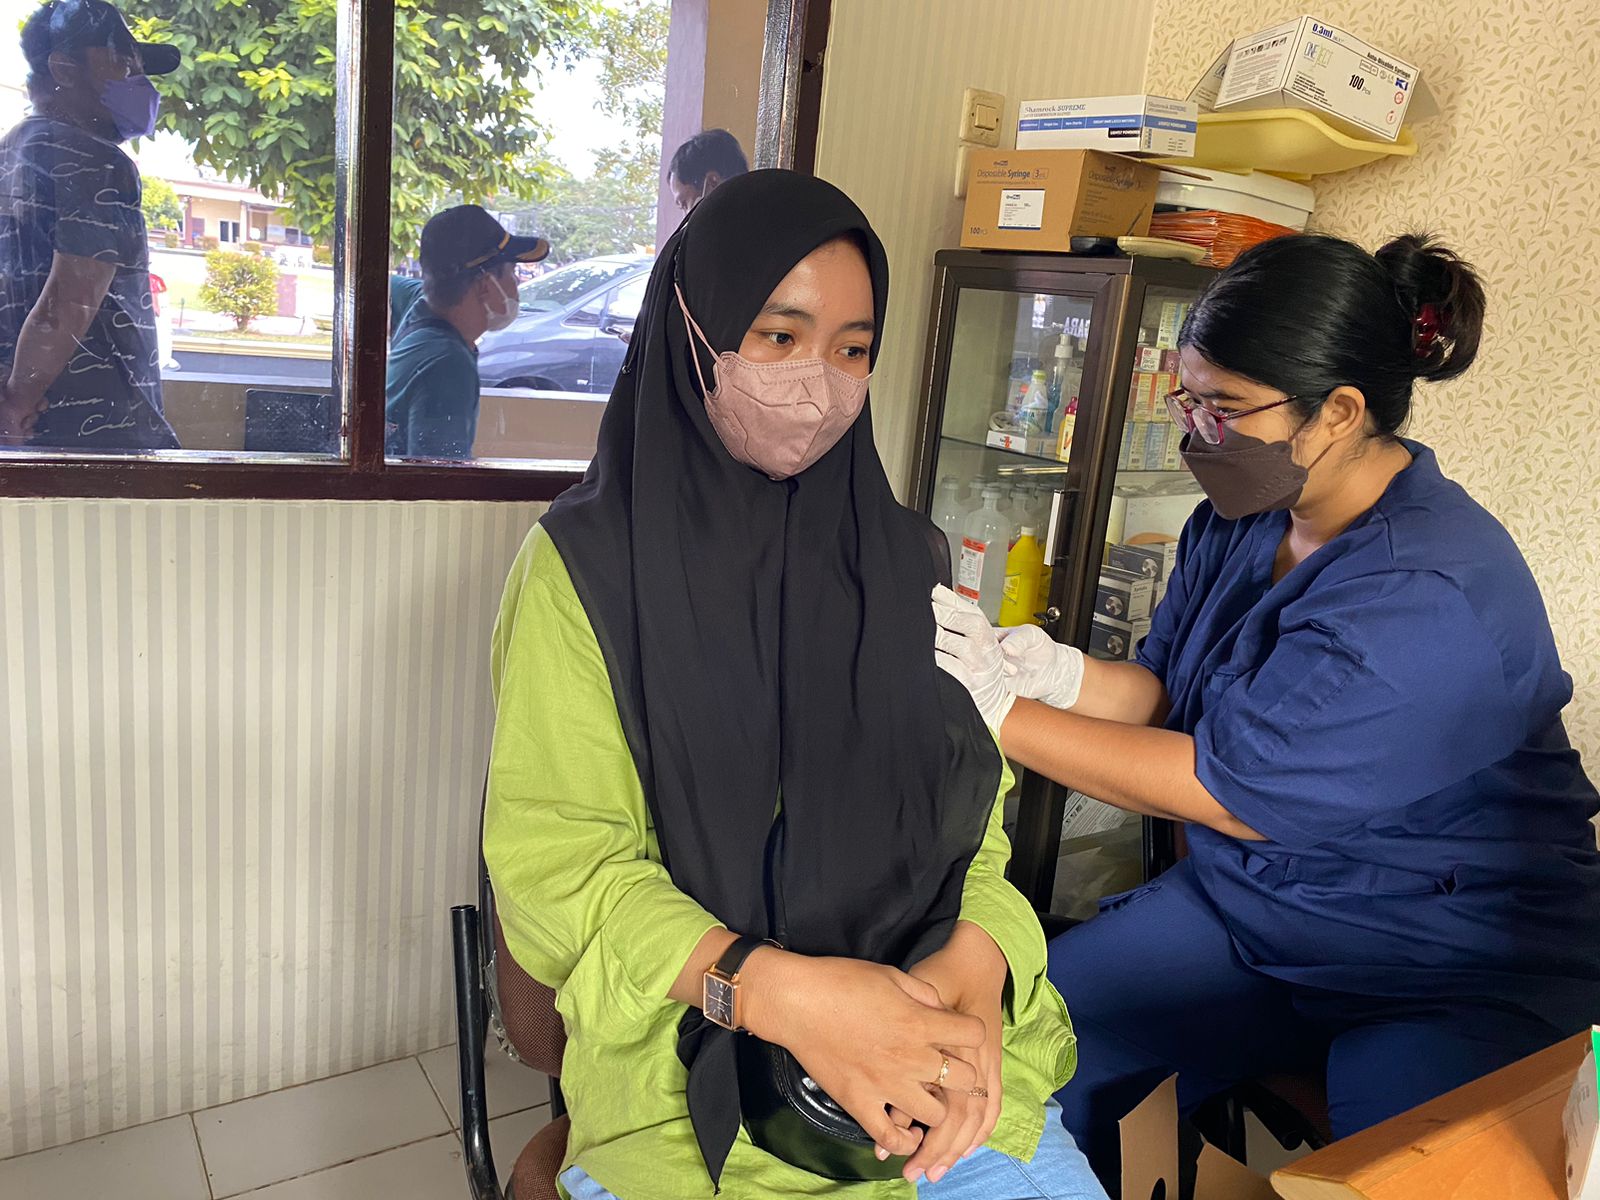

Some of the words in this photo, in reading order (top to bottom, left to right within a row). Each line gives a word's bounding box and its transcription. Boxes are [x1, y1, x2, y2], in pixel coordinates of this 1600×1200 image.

[1312, 23, 1333, 38] 0.3ml
[1349, 74, 1364, 91] 100
[1025, 105, 1056, 113] Shamrock
[1057, 104, 1086, 112] SUPREME
[1008, 168, 1030, 179] Syringe
